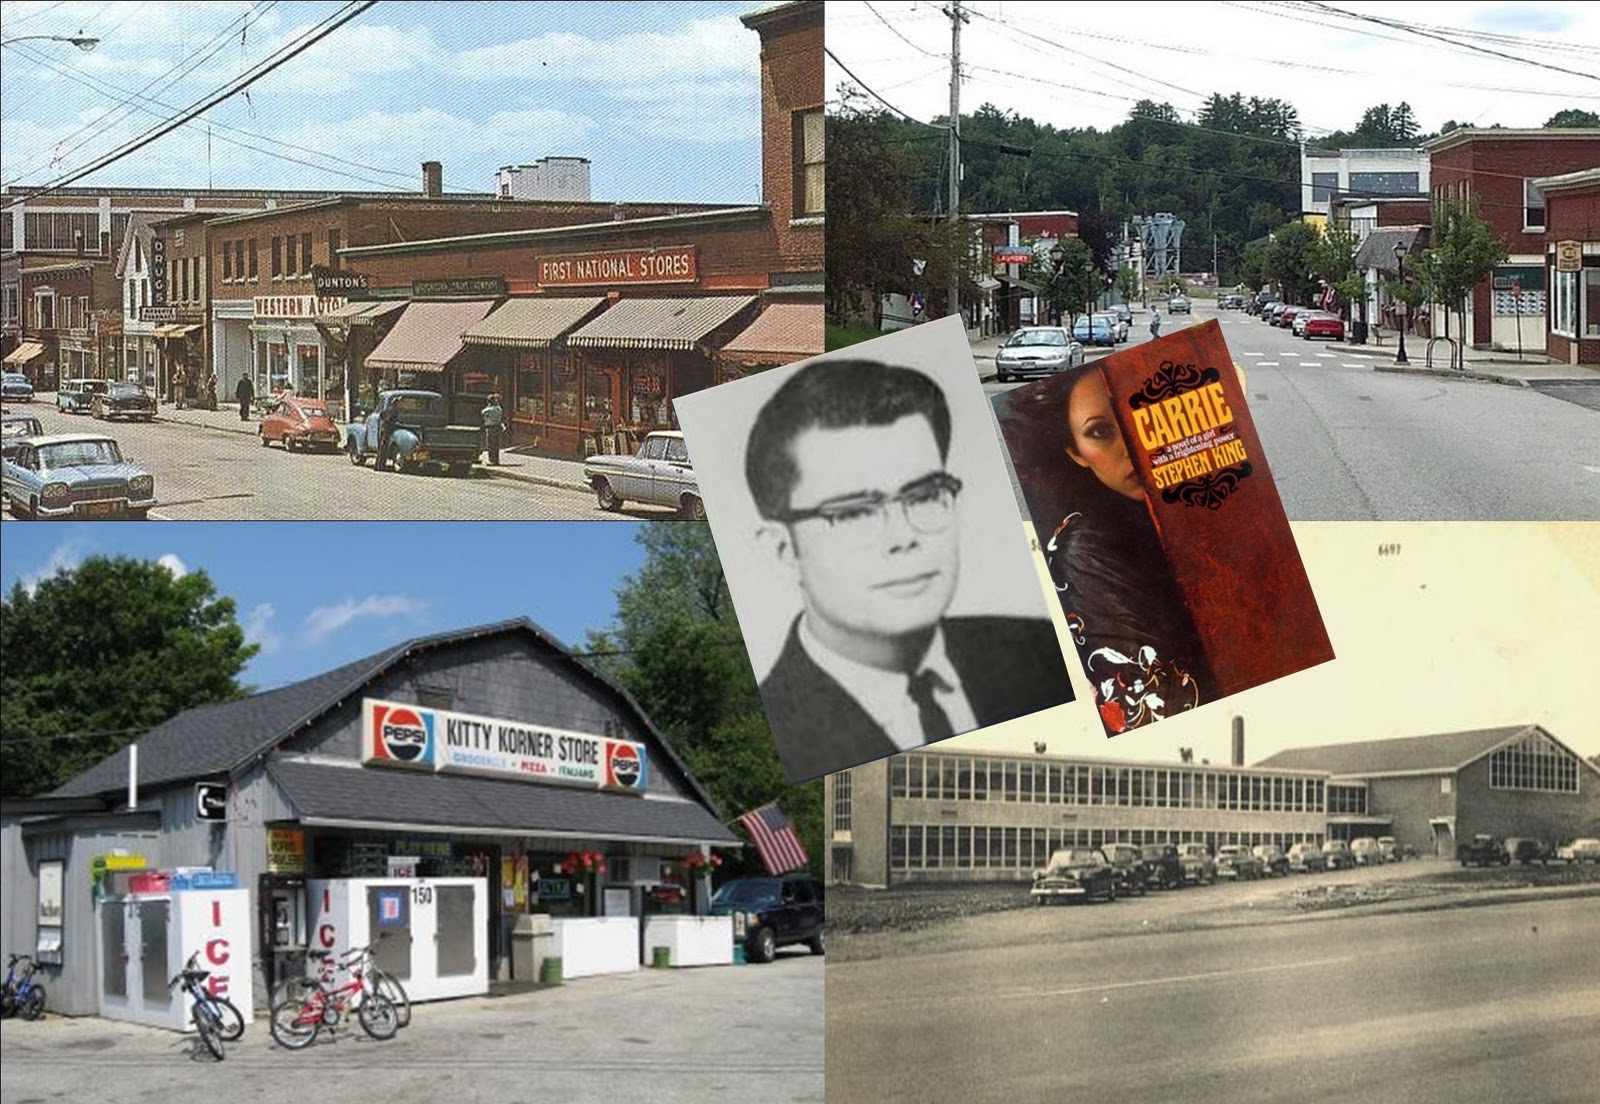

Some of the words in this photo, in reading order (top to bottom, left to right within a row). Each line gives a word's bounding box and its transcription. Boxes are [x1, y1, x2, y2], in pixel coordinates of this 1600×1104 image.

[543, 260, 572, 281] FIRST
[576, 255, 634, 279] NATIONAL
[639, 253, 690, 277] STORES
[317, 274, 368, 288] DUNTON'S
[255, 297, 304, 315] WESTERN
[1132, 381, 1234, 451] CARRIE
[1152, 453, 1169, 465] with
[1174, 440, 1214, 459] frightening
[1213, 432, 1235, 447] power
[1172, 437, 1190, 451] novel
[1190, 434, 1198, 444] of
[1202, 429, 1216, 442] girl
[1151, 449, 1214, 489] STEPHEN
[1211, 438, 1248, 470] KING
[383, 724, 426, 744] PEPSI
[446, 718, 492, 750] KITTY
[498, 726, 554, 759] KORNER
[558, 736, 599, 765] STORE
[520, 760, 548, 774] PIZZA
[612, 757, 640, 772] PEPSI
[412, 887, 433, 904] 150
[205, 899, 230, 1004] ICE
